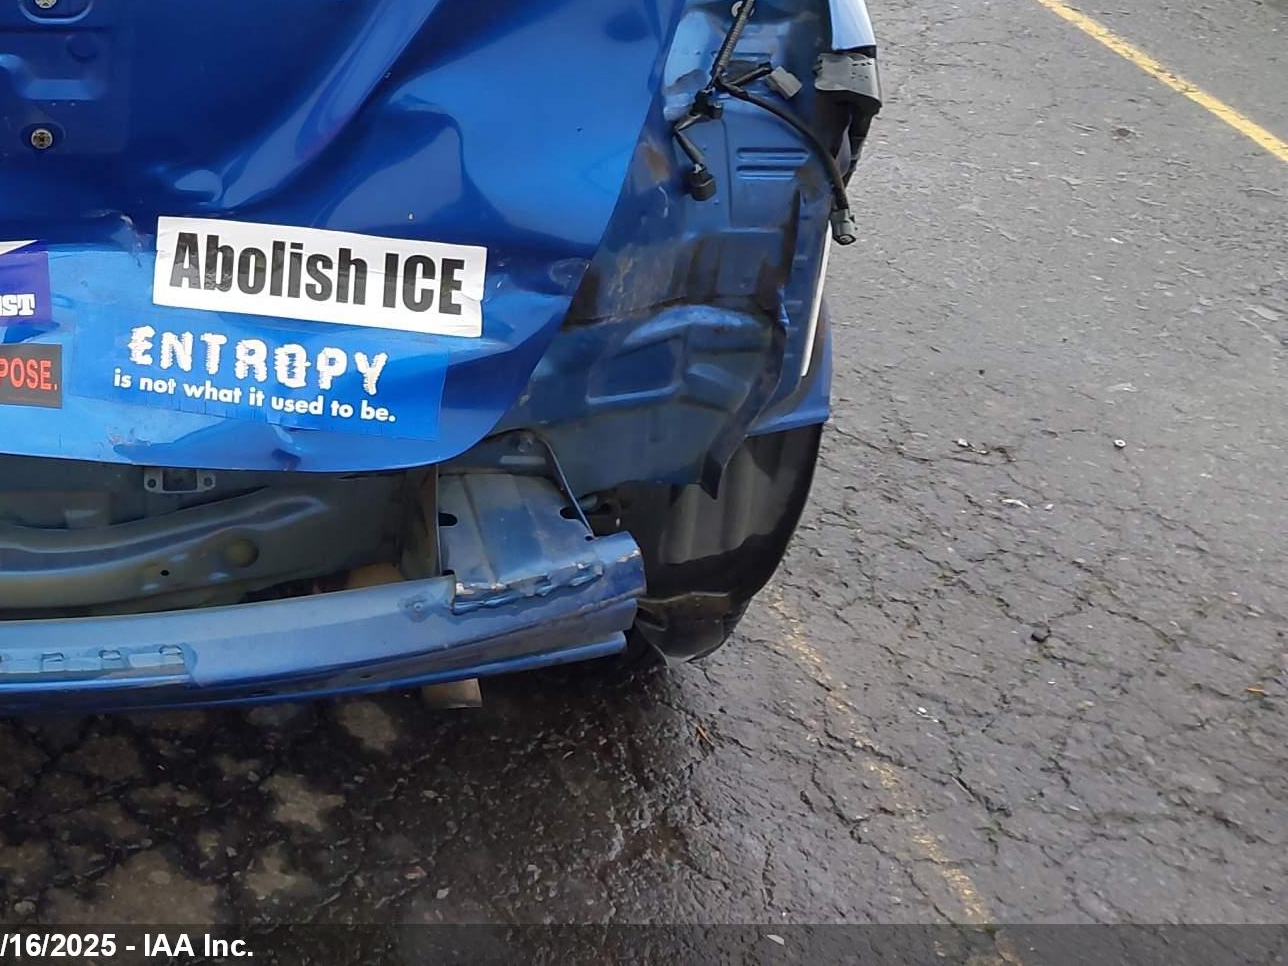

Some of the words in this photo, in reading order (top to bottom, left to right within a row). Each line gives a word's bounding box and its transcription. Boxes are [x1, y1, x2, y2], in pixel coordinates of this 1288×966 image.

[169, 231, 369, 306] Abolish
[382, 252, 465, 316] ICE
[113, 368, 132, 388] is
[139, 377, 176, 395] not
[182, 383, 243, 404] what
[248, 386, 265, 407] it
[271, 395, 324, 416] used
[330, 400, 354, 418] to
[360, 402, 397, 422] be.
[126, 325, 389, 395] ENTROPY
